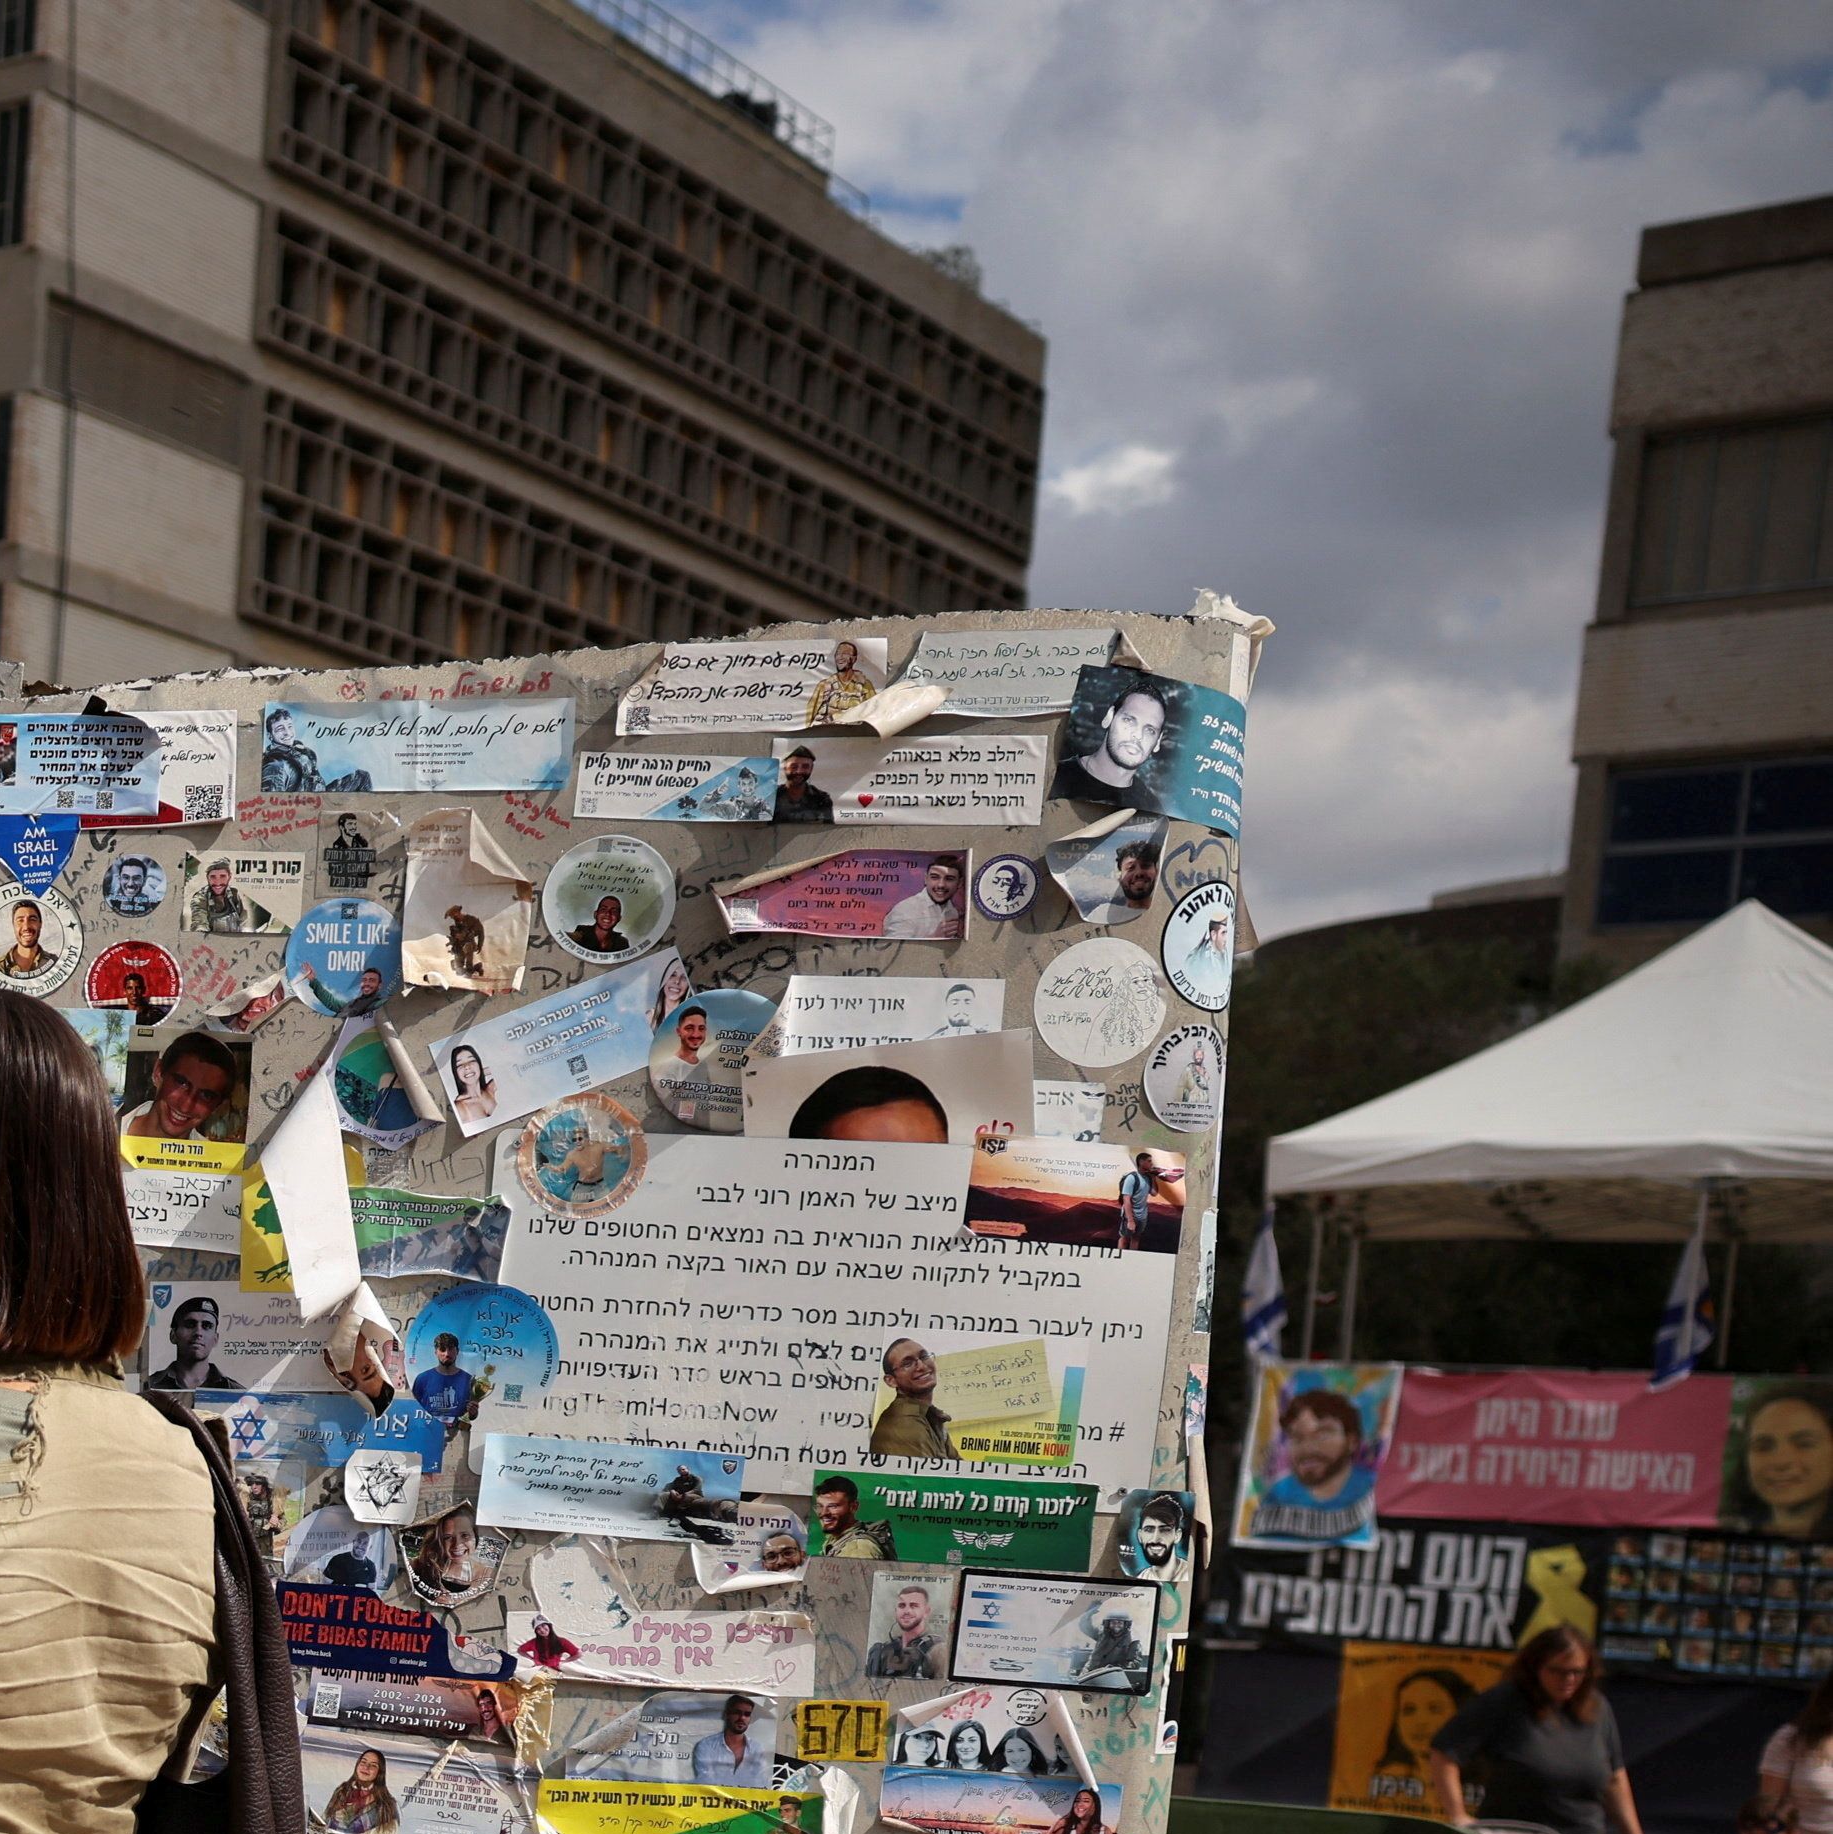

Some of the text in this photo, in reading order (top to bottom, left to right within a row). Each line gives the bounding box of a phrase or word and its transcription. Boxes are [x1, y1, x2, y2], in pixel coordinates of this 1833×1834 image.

[24, 827, 47, 839] AM
[14, 839, 58, 854] ISRAEL
[19, 853, 53, 868] CHAI
[306, 923, 393, 945] SMILE LIKE
[328, 951, 366, 972] OMRI
[785, 1153, 874, 1171] המנהרה
[697, 1183, 956, 1212] מיצב של האמן רוני לבבי
[1474, 1398, 1618, 1440] ענבר הימן
[961, 1438, 1069, 1457] BRING HIM HOME NOW!
[1475, 1445, 1580, 1487] היחידה
[1585, 1449, 1695, 1494] האישה
[283, 1591, 349, 1619] DON'T
[1240, 1576, 1518, 1646] את החטופים
[278, 1623, 431, 1653] THE BIBAS FAMILY
